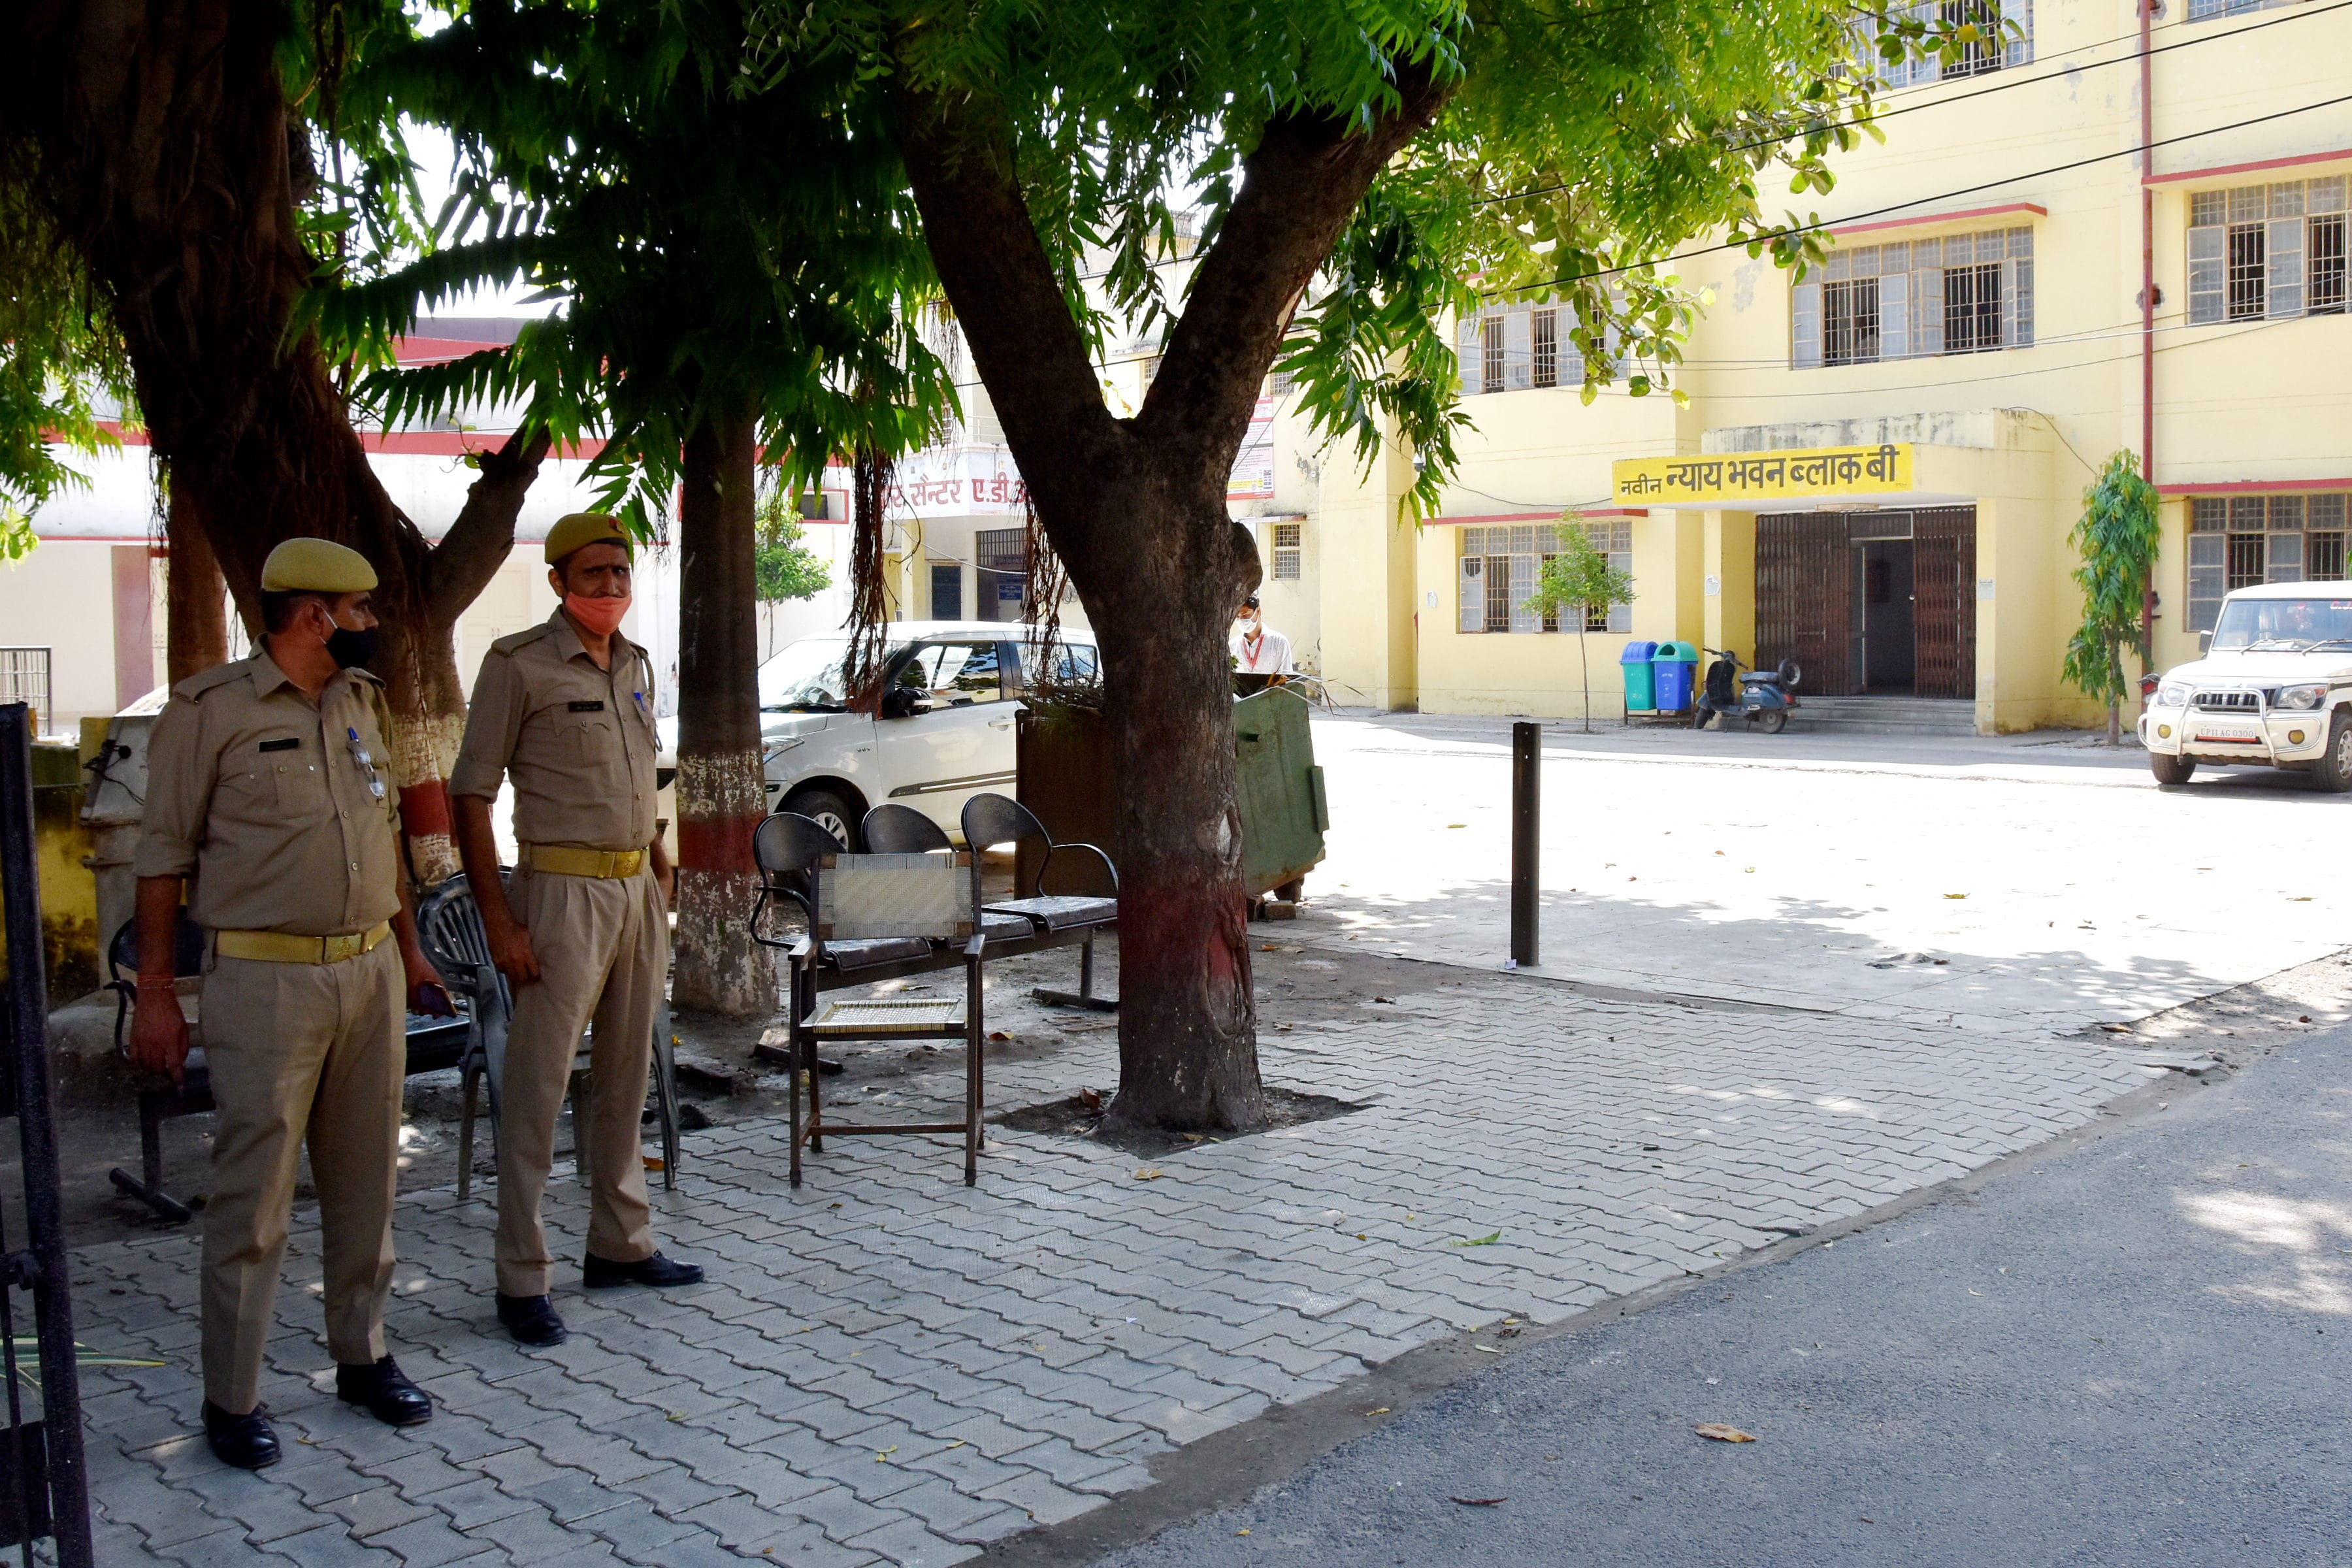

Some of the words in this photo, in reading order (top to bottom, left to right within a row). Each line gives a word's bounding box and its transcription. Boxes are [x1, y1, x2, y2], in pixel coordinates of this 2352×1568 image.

[1620, 473, 1662, 495] नवीन
[1666, 461, 1723, 492] न्याय
[1727, 457, 1786, 489] भवन
[1790, 453, 1863, 485] ब्लाक
[1866, 444, 1901, 482] बी
